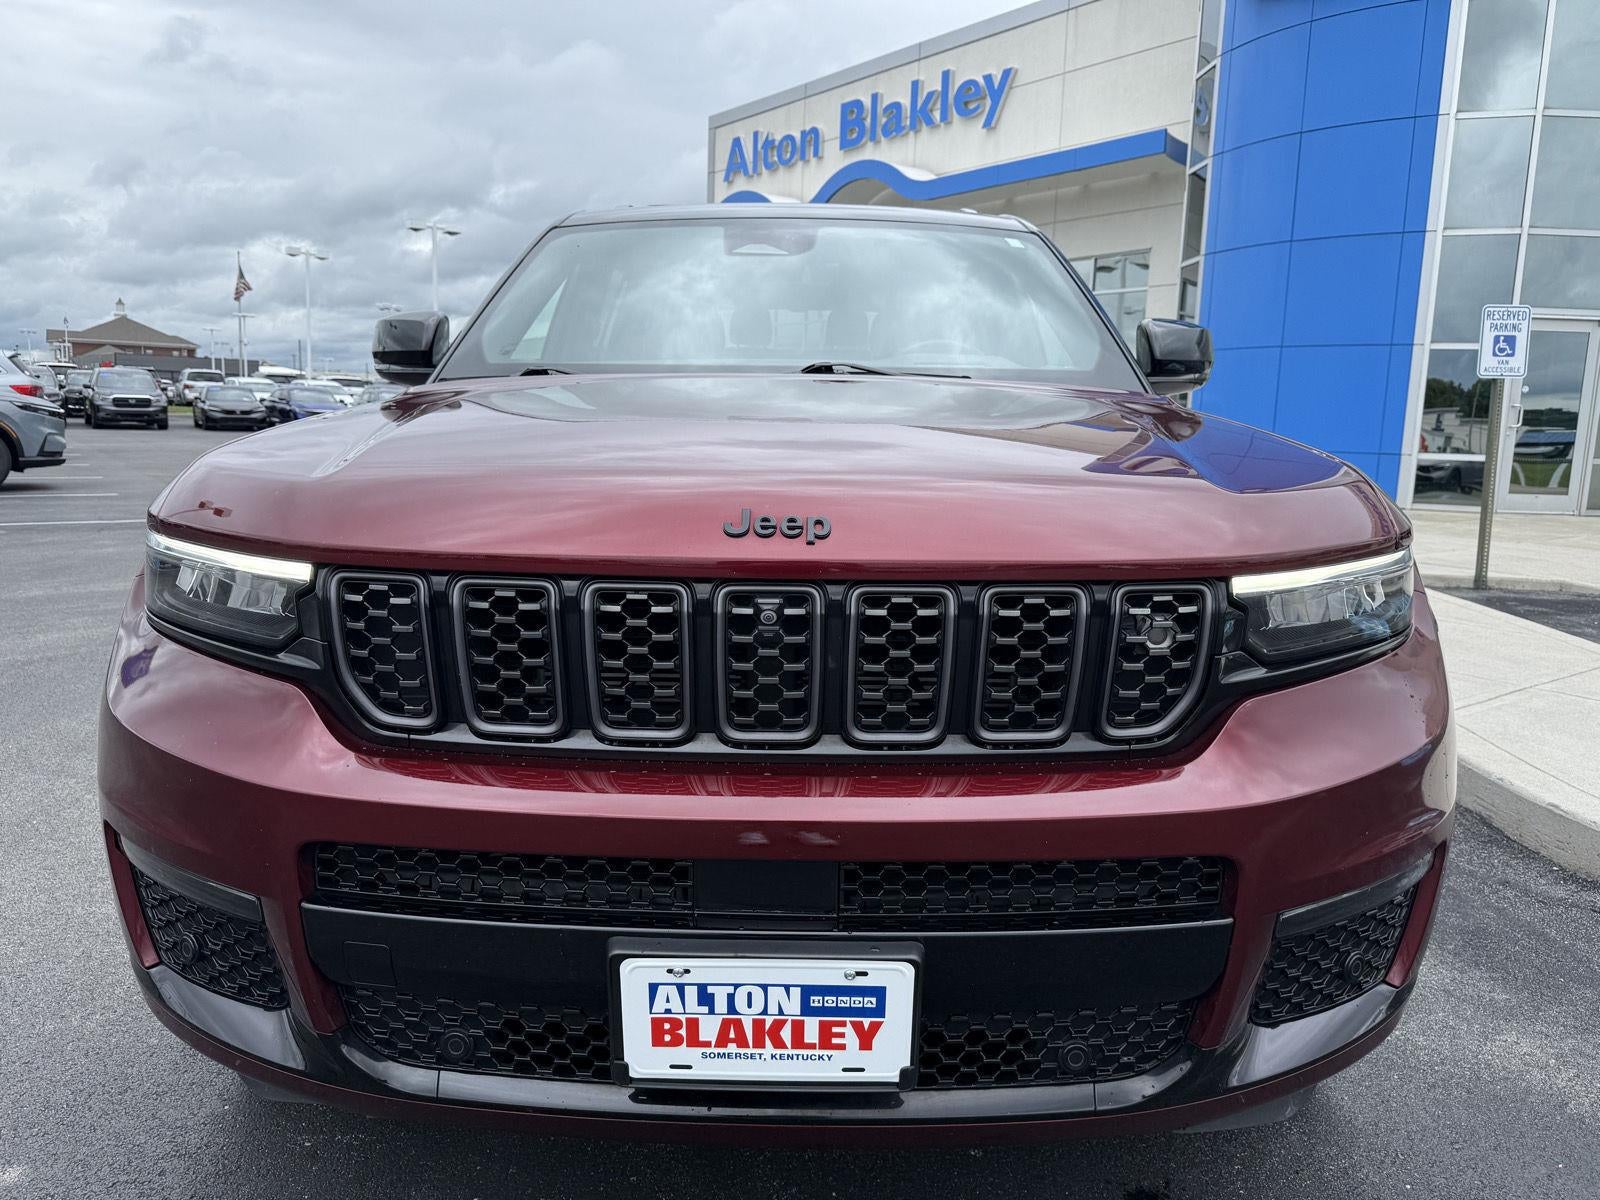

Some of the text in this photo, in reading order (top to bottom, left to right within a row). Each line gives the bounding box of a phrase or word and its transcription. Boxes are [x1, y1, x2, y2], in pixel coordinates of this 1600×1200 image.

[723, 66, 1017, 182] Alton Blakley
[1486, 310, 1527, 321] RESERVED
[1490, 322, 1522, 333] PARKING
[1483, 366, 1522, 374] ACCESSIBLE
[723, 508, 832, 545] Jeep
[651, 985, 877, 1015] ALTON HONDA
[650, 1017, 885, 1051] BLAKLEY
[701, 1051, 833, 1062] SOMERSET, KENTUCKY
